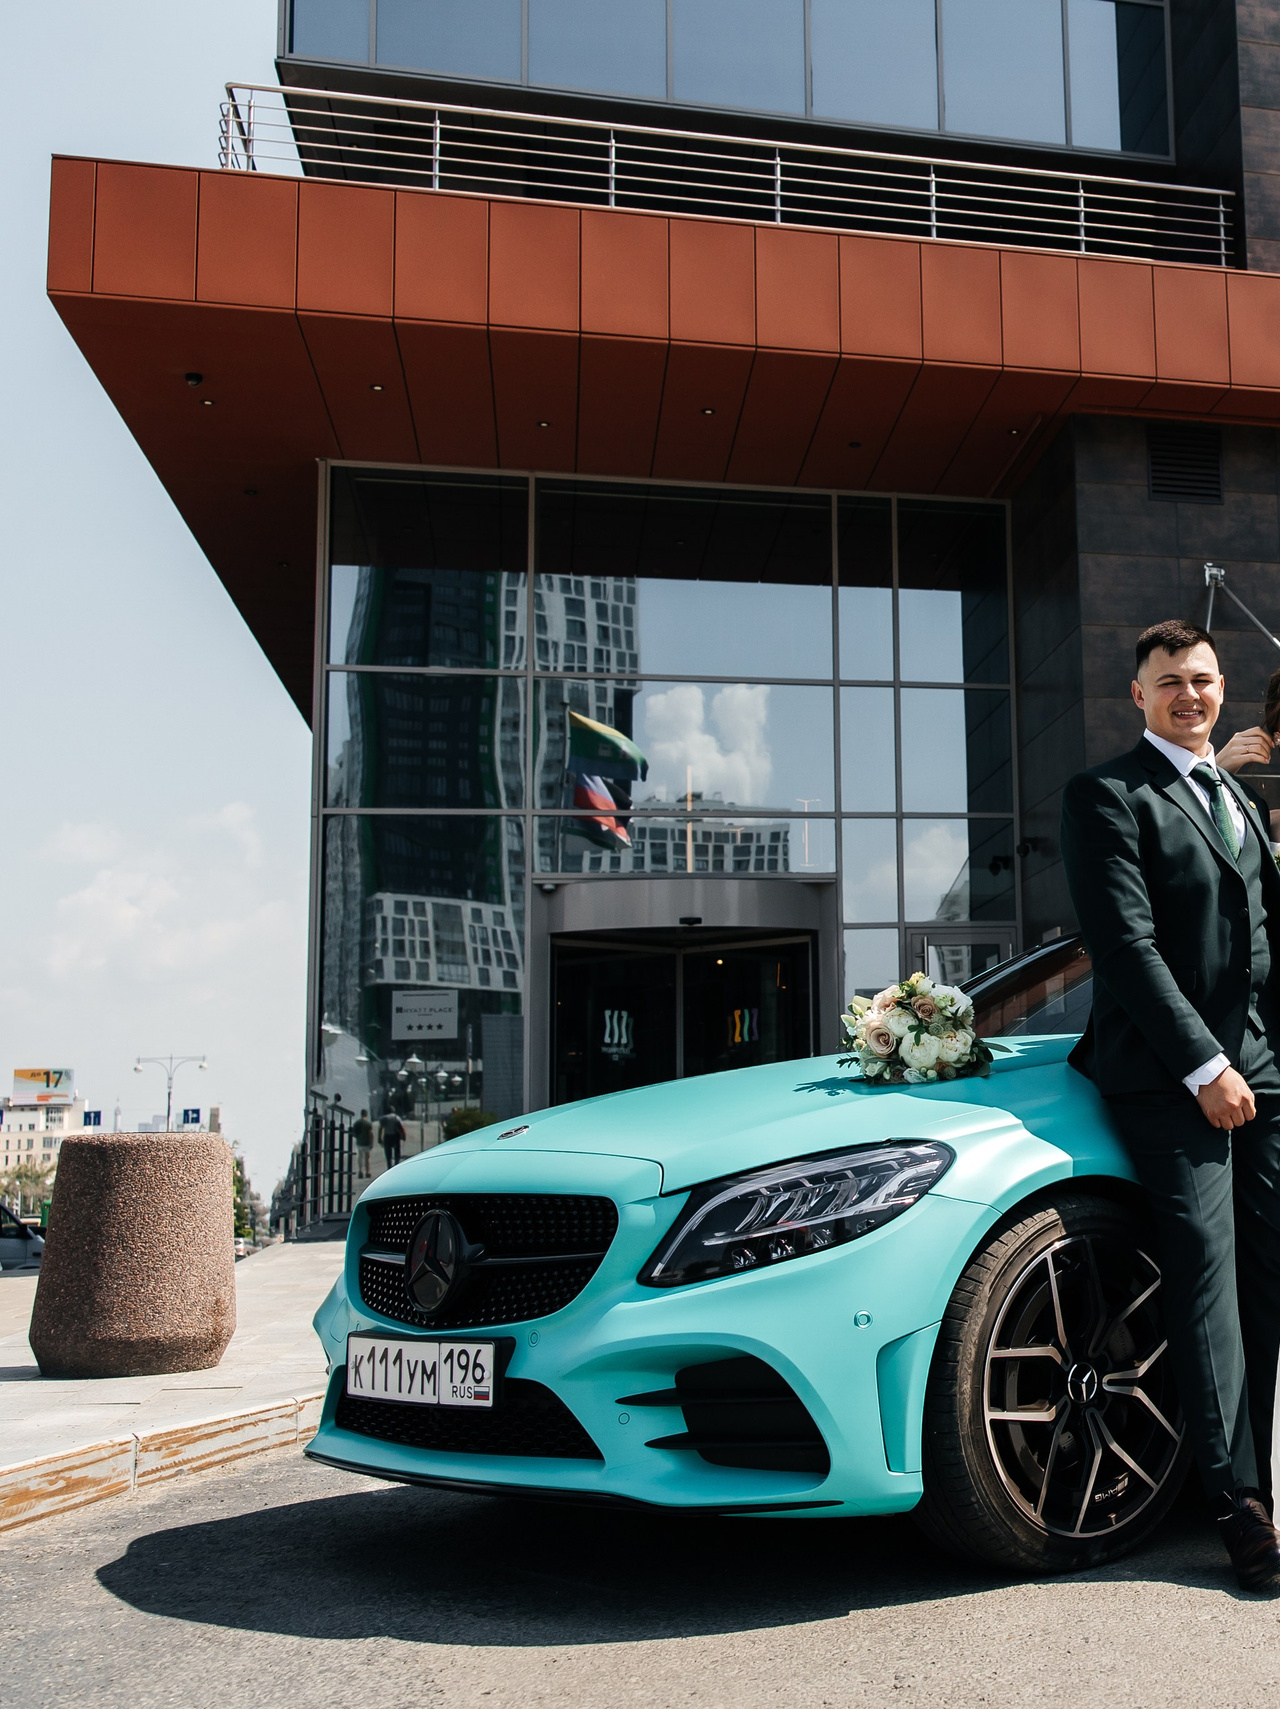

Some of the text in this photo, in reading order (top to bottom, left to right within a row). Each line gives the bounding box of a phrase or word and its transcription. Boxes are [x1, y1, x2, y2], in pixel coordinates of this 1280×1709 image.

[353, 1346, 486, 1397] К111УМ 196
[451, 1385, 473, 1399] RUS
